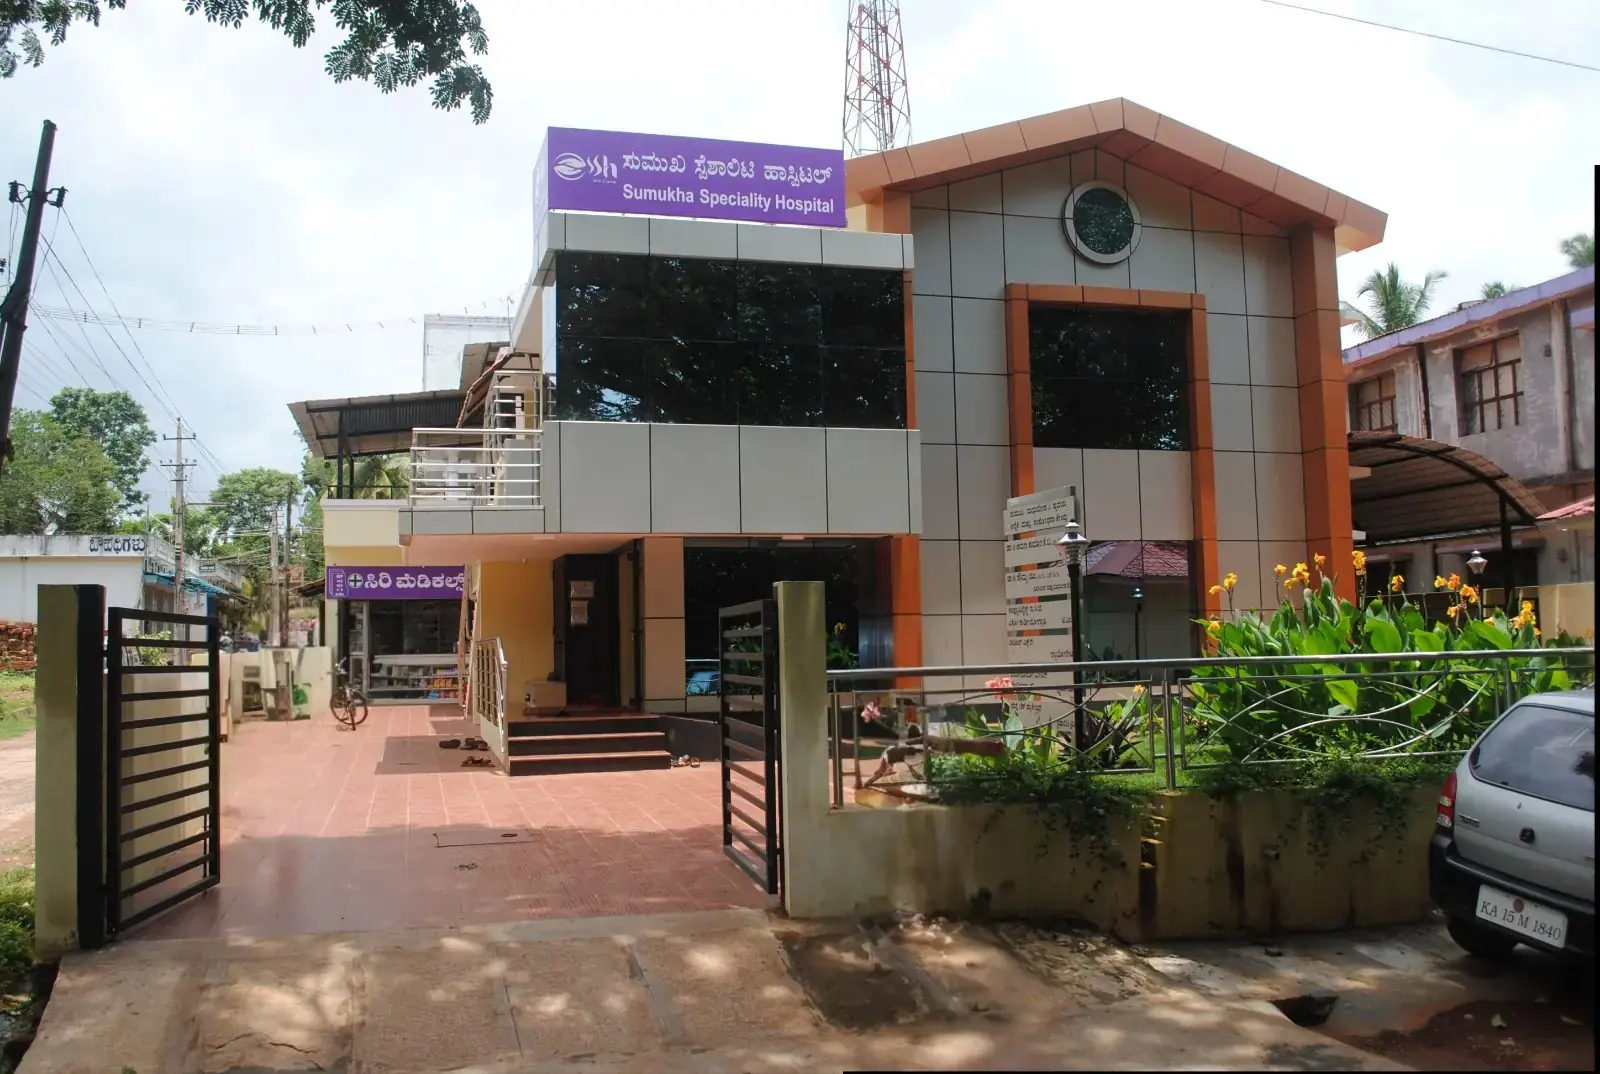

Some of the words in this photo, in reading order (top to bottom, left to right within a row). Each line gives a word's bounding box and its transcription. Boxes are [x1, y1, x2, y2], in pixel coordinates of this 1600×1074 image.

[622, 151, 686, 173] ಸುಮುಖ
[763, 165, 833, 187] ಹಾಸ್ಪಿಟಲ್
[622, 183, 695, 203] Sumukha
[699, 188, 772, 212] Speciality
[775, 194, 834, 214] Hospital
[364, 572, 393, 588] ಸಿರಿ
[1480, 901, 1499, 918] KA
[1502, 909, 1515, 924] 15
[1517, 914, 1530, 929] M
[1533, 920, 1562, 941] 1840
